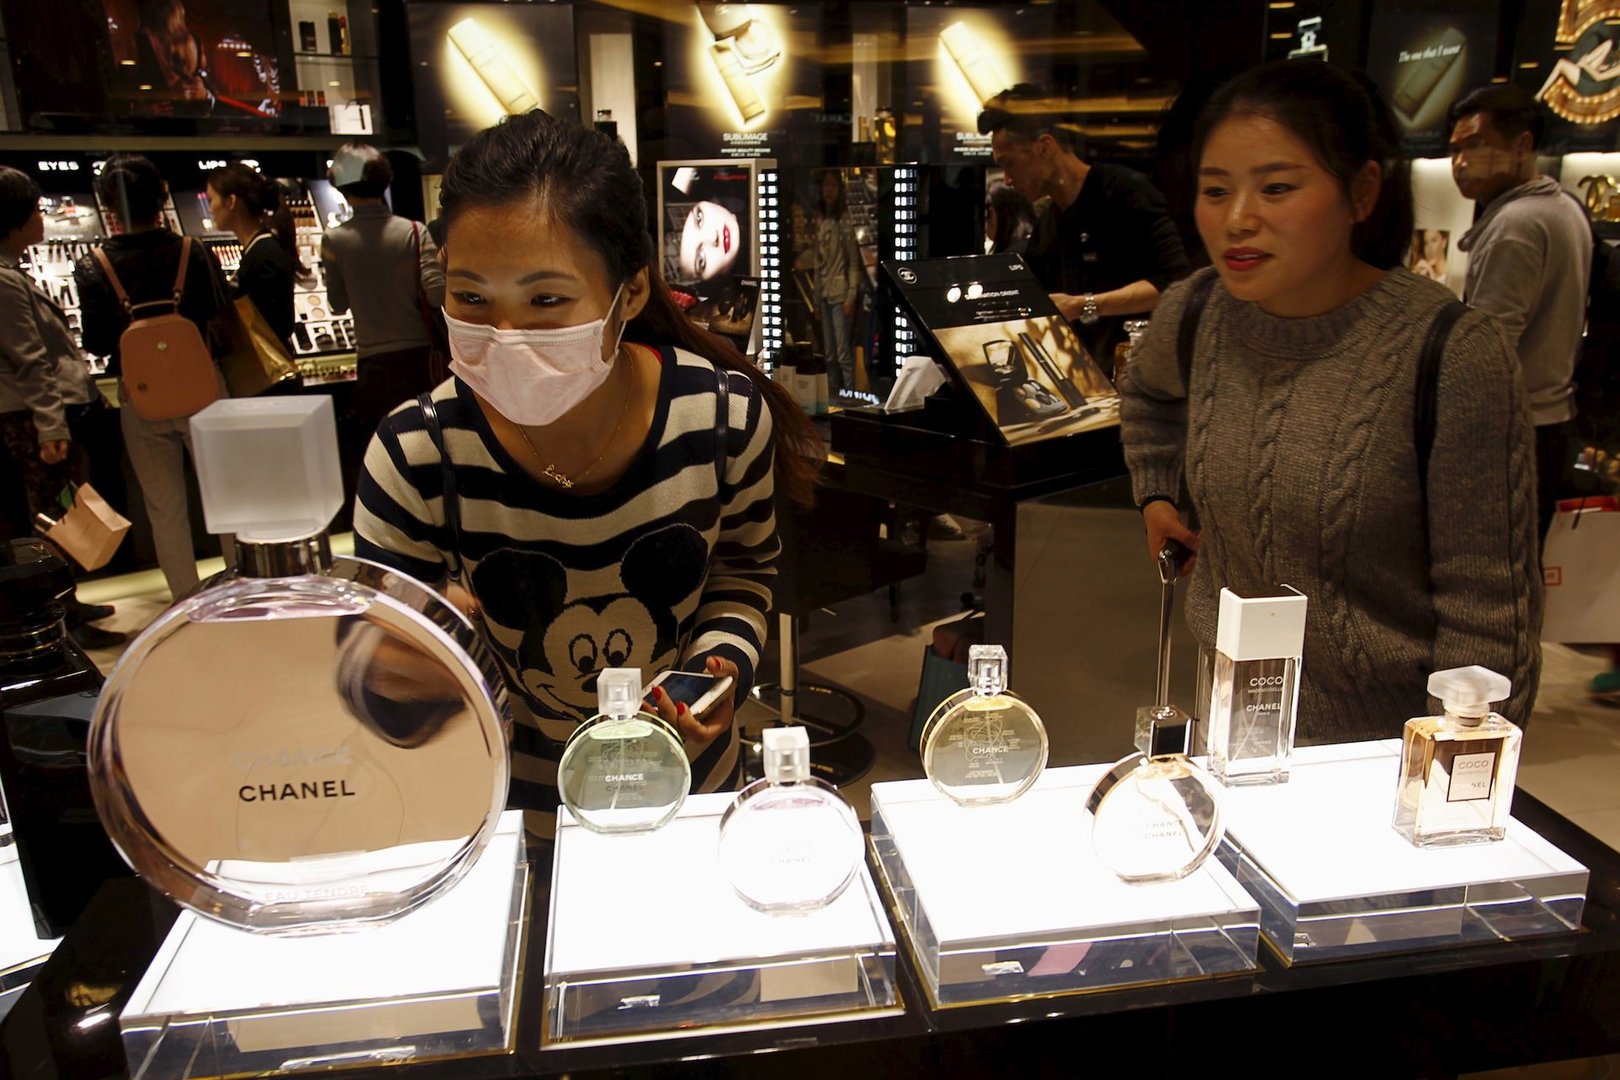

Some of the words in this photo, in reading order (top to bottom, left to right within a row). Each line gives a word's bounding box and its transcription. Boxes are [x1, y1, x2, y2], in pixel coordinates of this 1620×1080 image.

[723, 132, 768, 141] SUBLIMAGE
[38, 161, 79, 171] EYES
[1250, 676, 1283, 687] COCO
[1246, 702, 1281, 712] CHANEL
[972, 746, 1009, 755] CHANCE
[1458, 760, 1489, 769] COCO
[605, 773, 644, 782] CHANCE
[239, 780, 355, 802] CHANEL
